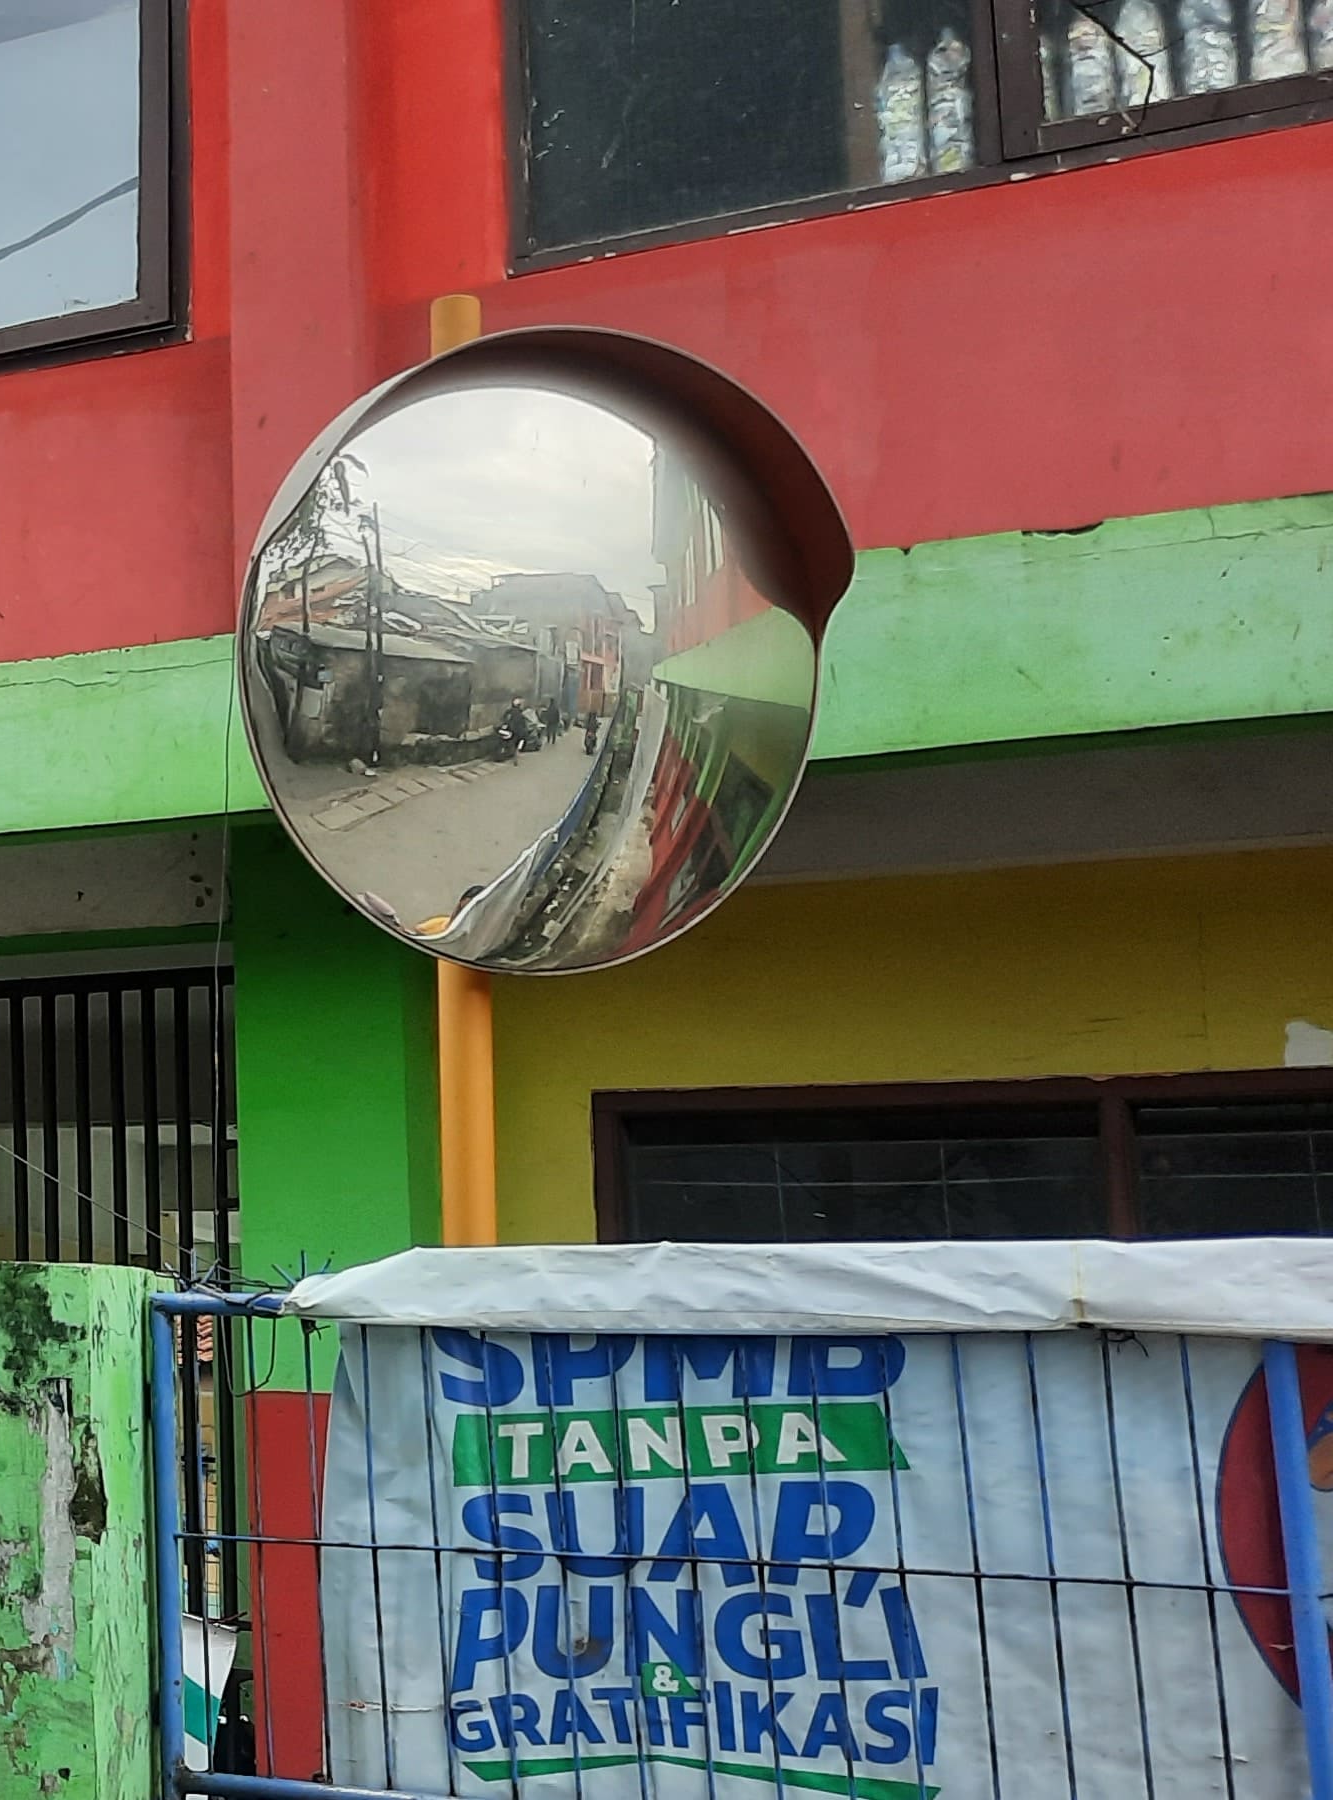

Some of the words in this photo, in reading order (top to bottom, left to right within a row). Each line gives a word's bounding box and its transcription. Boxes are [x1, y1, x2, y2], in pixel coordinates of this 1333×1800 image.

[433, 1332, 906, 1407] SPMB
[498, 1413, 846, 1478] TANPA
[462, 1481, 881, 1608] SUAP,
[452, 1586, 928, 1693] PUNGLI
[651, 1665, 679, 1693] &
[451, 1687, 939, 1766] GRATIFIKASI
